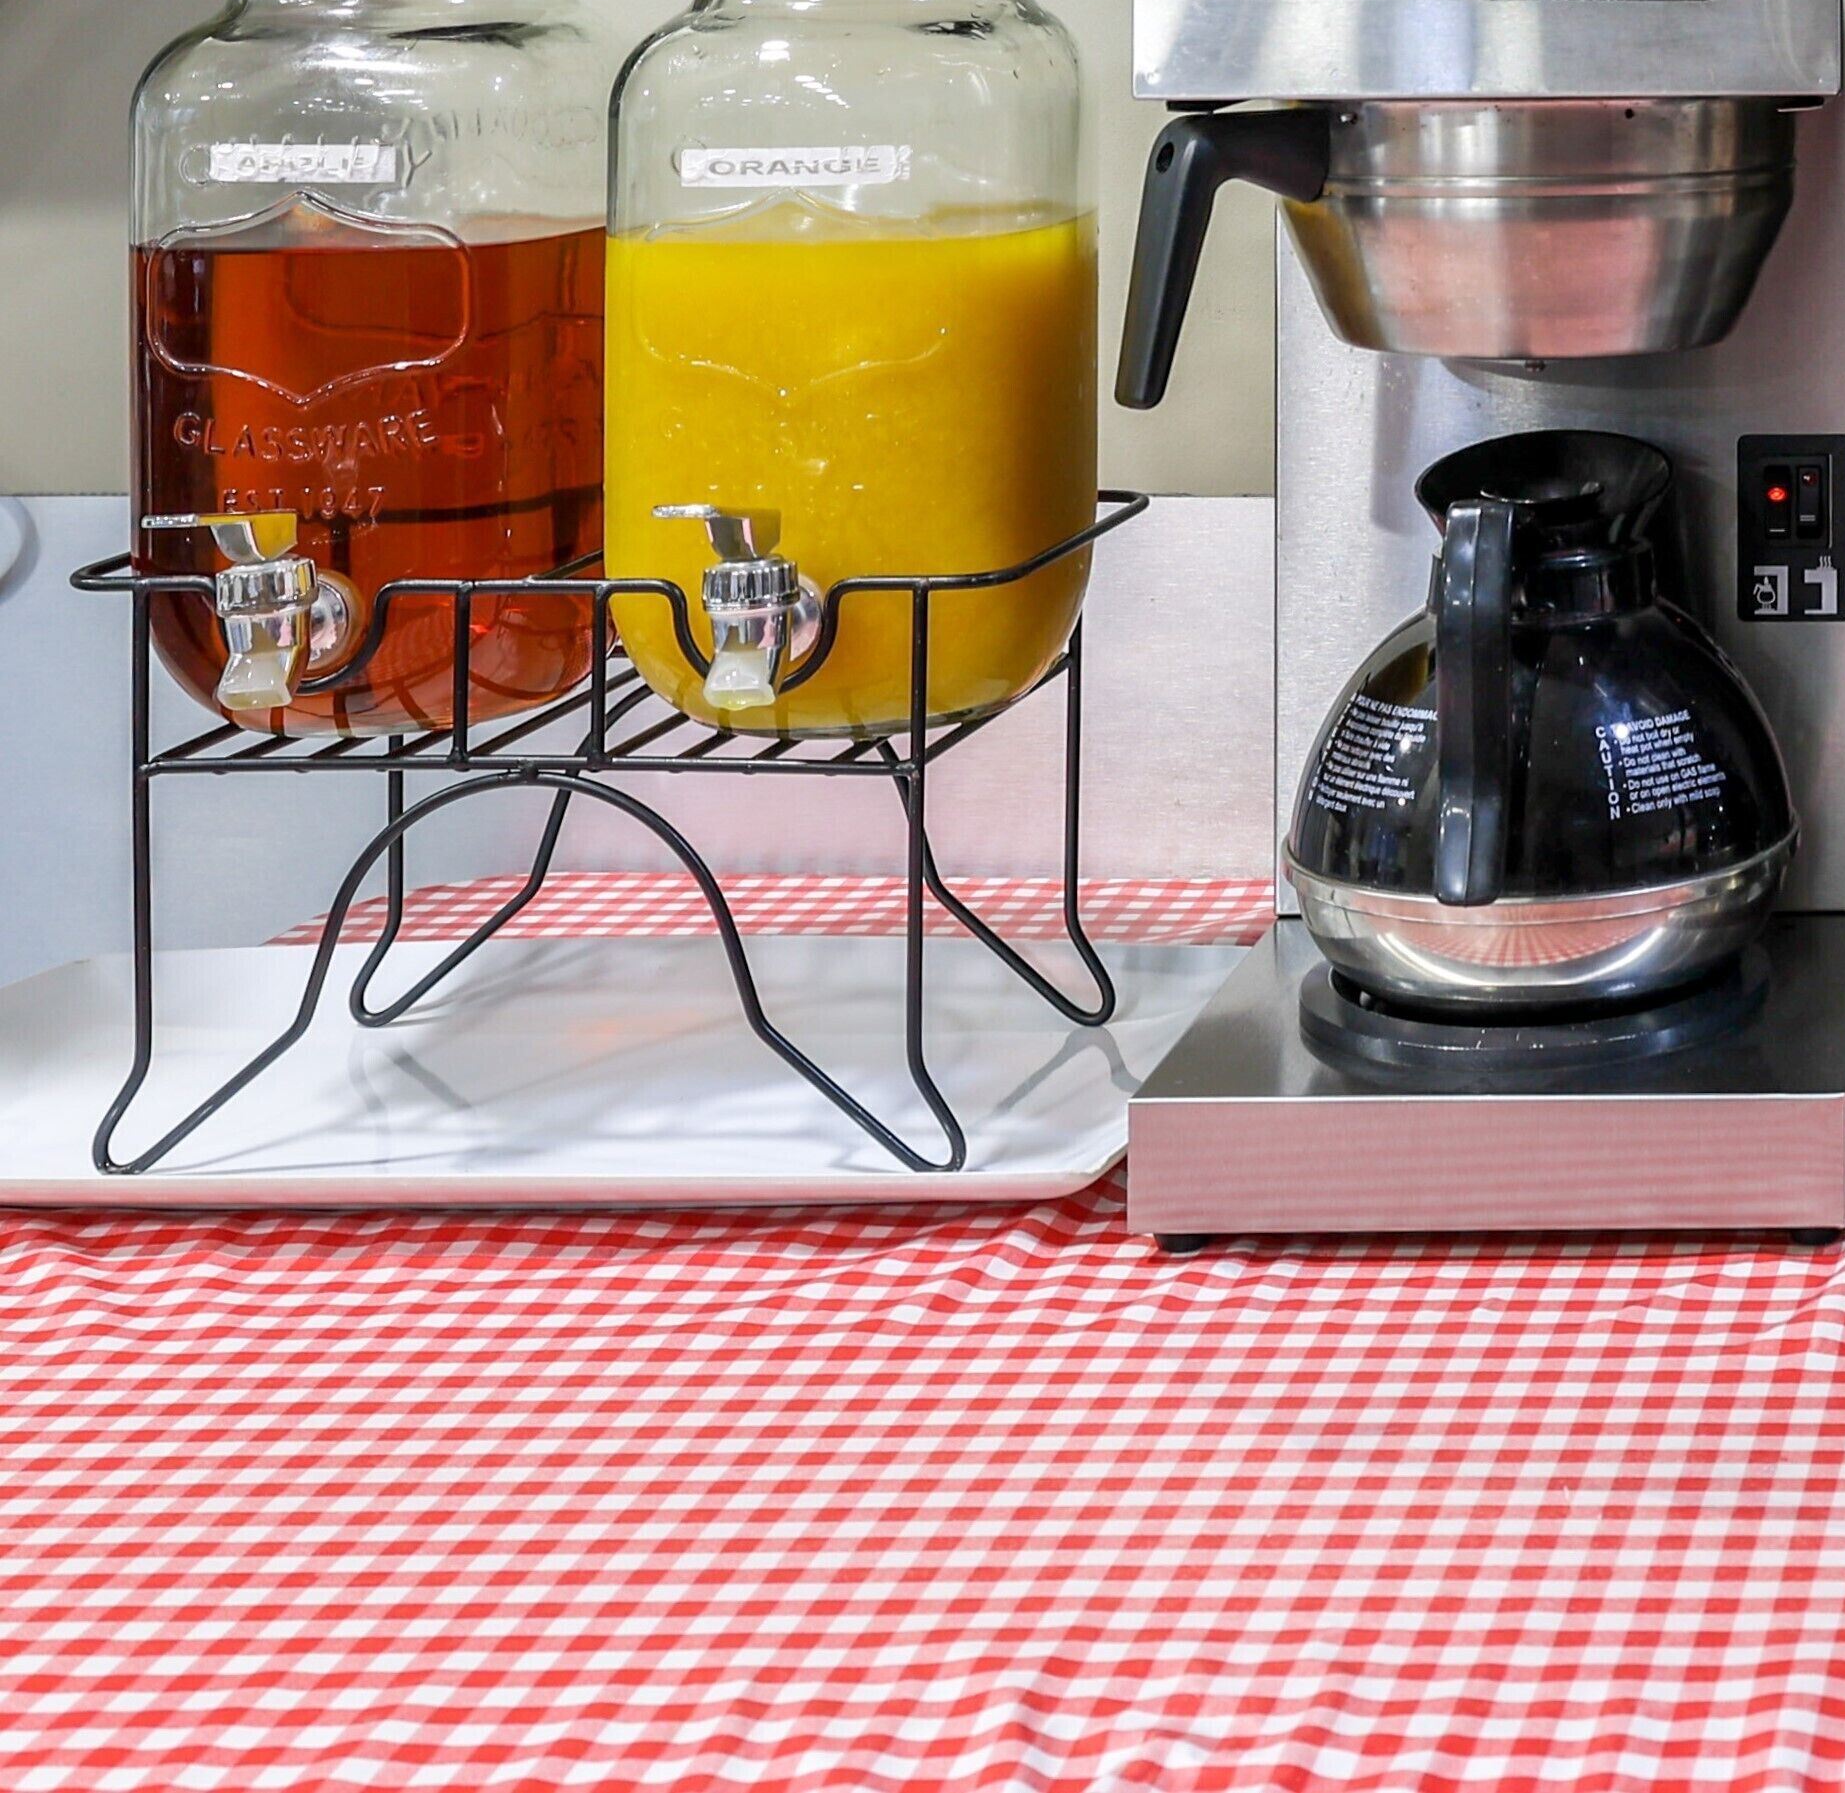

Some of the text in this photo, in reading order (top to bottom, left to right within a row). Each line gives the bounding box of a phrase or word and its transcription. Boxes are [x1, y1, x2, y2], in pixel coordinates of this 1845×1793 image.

[708, 157, 882, 176] ORANGE
[173, 408, 440, 462] GLASSWARE
[1378, 700, 1393, 714] PAS
[1655, 709, 1691, 727] DAMAGE
[1632, 732, 1645, 743] not
[1660, 727, 1671, 740] dry
[1673, 726, 1680, 734] or
[1640, 742, 1653, 752] pot
[1624, 757, 1636, 767] Do
[1637, 755, 1650, 765] not
[1596, 726, 1620, 820] CAUTION
[1628, 780, 1640, 790] Do
[1642, 776, 1655, 787] not
[1656, 775, 1669, 784] use
[1670, 772, 1680, 781] on
[1680, 767, 1697, 779] GAS
[1629, 792, 1639, 800] or
[1640, 789, 1651, 798] on
[1652, 785, 1671, 797] open
[1631, 799, 1655, 813] Clean
[1656, 796, 1672, 809] only
[1689, 789, 1703, 801] mild
